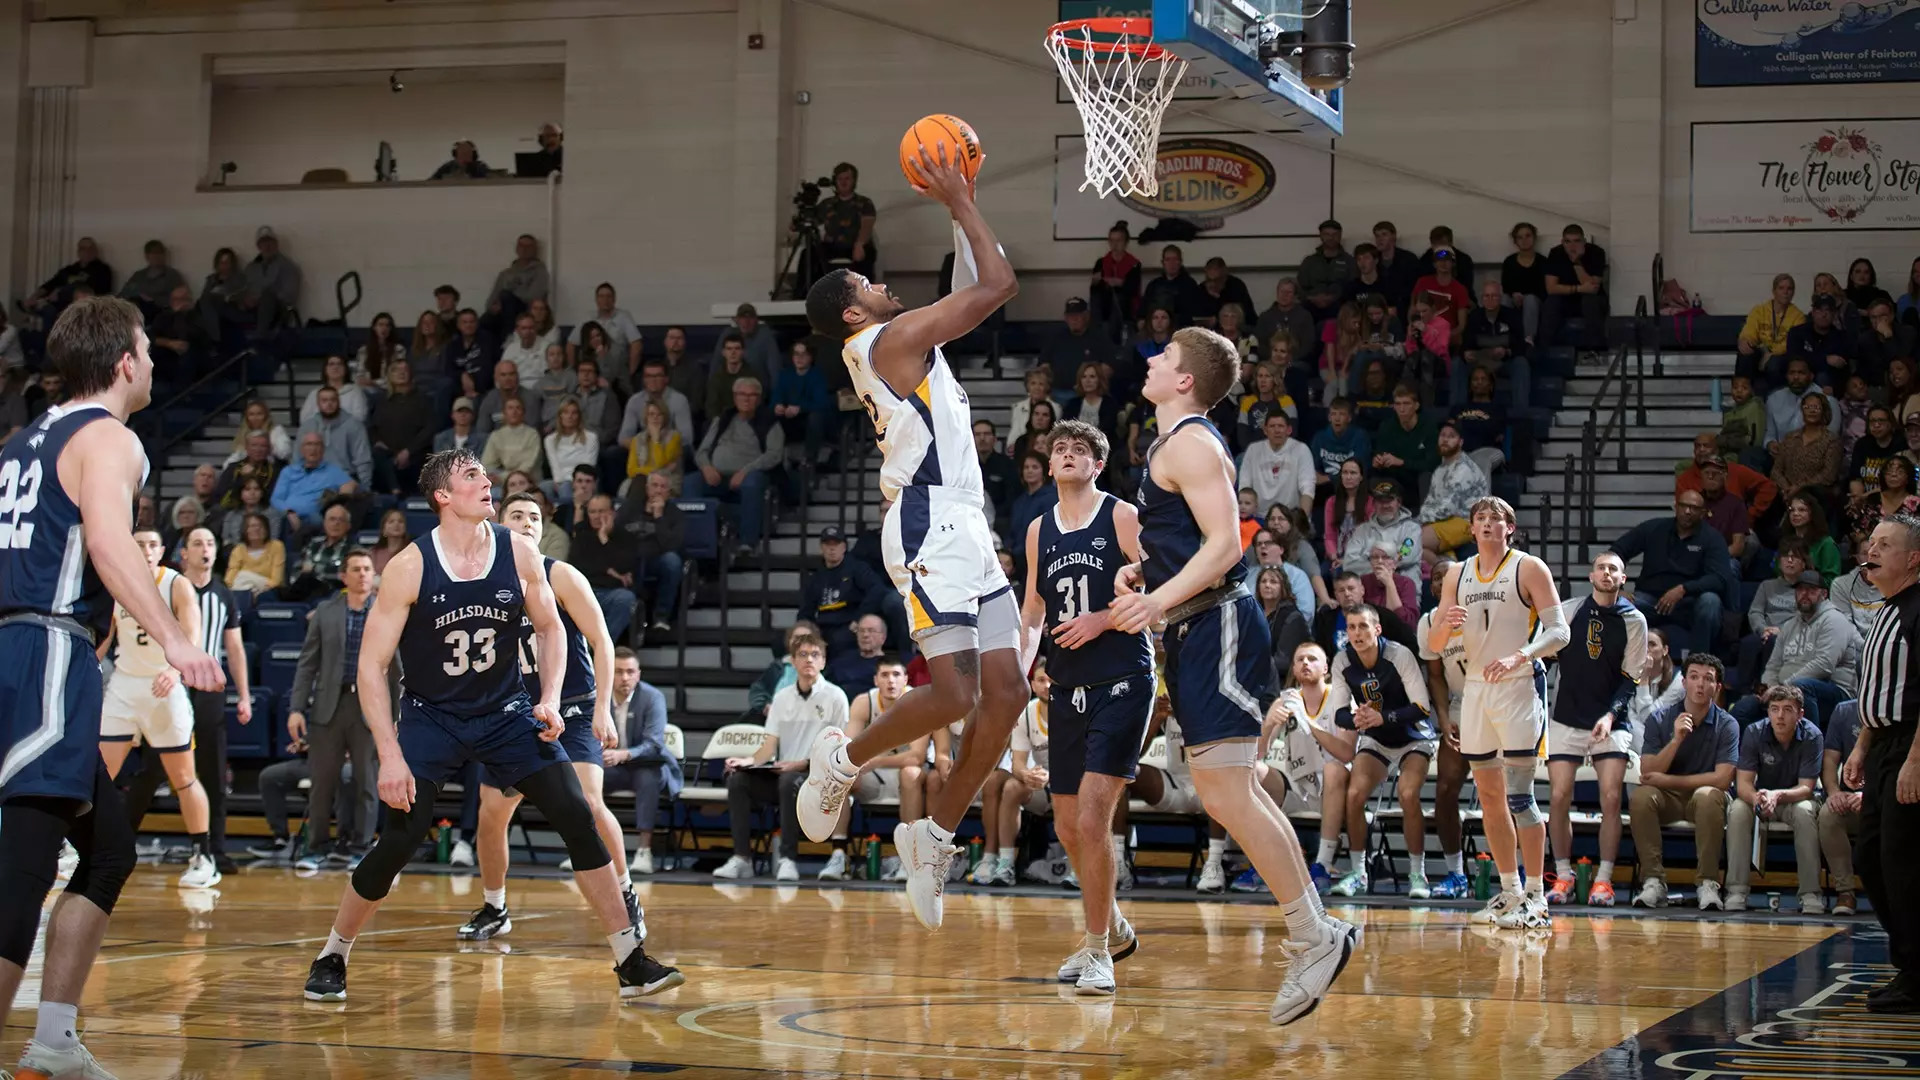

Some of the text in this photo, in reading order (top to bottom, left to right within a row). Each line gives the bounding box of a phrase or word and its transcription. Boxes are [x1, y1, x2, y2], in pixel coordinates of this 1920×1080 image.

[1775, 48, 1917, 63] Culligan Water of Fairborn
[1206, 155, 1243, 180] BROS.
[1758, 161, 1800, 193] The
[1807, 160, 1873, 192] Flower
[0, 457, 43, 550] 22
[1046, 552, 1104, 578] HILLSDALE
[1056, 574, 1092, 623] 31
[1465, 591, 1506, 606] CEDARVILLE
[434, 605, 509, 630] HILLSDALE
[1484, 609, 1489, 631] 1
[442, 627, 498, 677] 33
